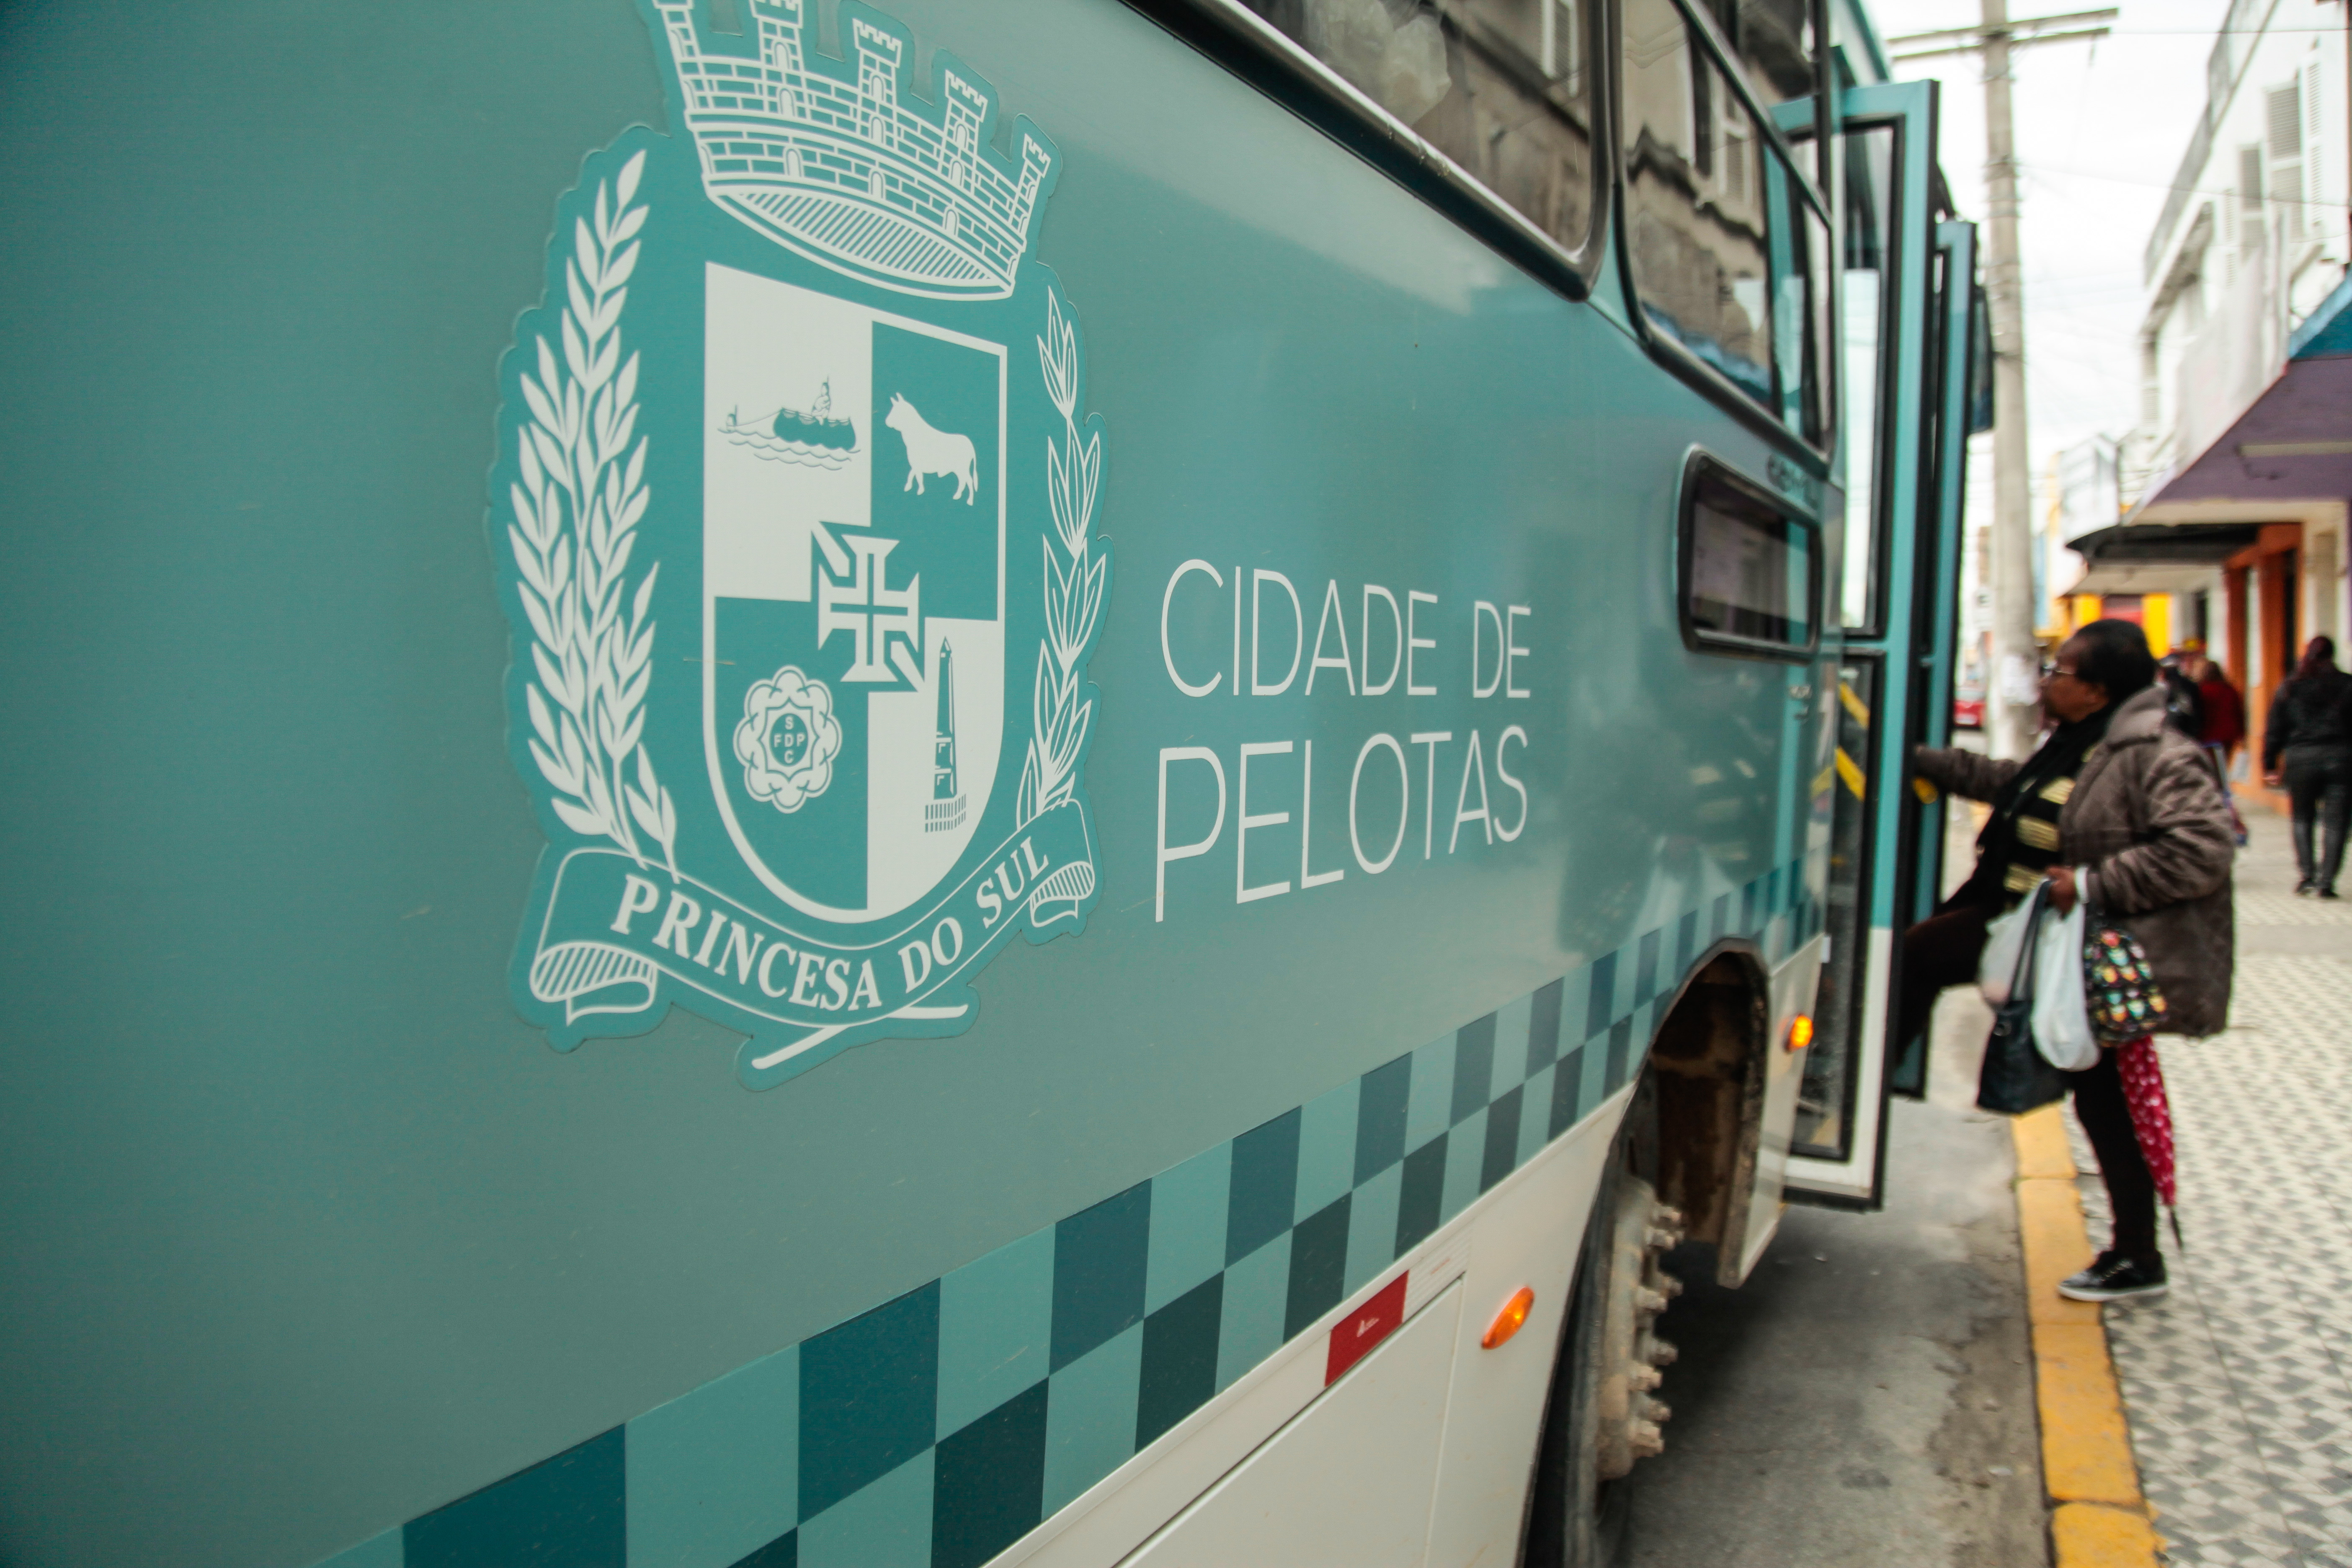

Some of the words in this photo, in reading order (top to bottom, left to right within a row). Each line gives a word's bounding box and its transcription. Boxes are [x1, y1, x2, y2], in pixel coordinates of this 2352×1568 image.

[1161, 559, 1438, 697] CIDADE
[1473, 601, 1531, 698] DE
[784, 750, 793, 763] C
[785, 716, 794, 730] S
[1155, 725, 1528, 923] PELOTAS
[610, 874, 882, 1011] PRINCESA
[897, 917, 963, 993] DO
[976, 836, 1049, 929] SUL
